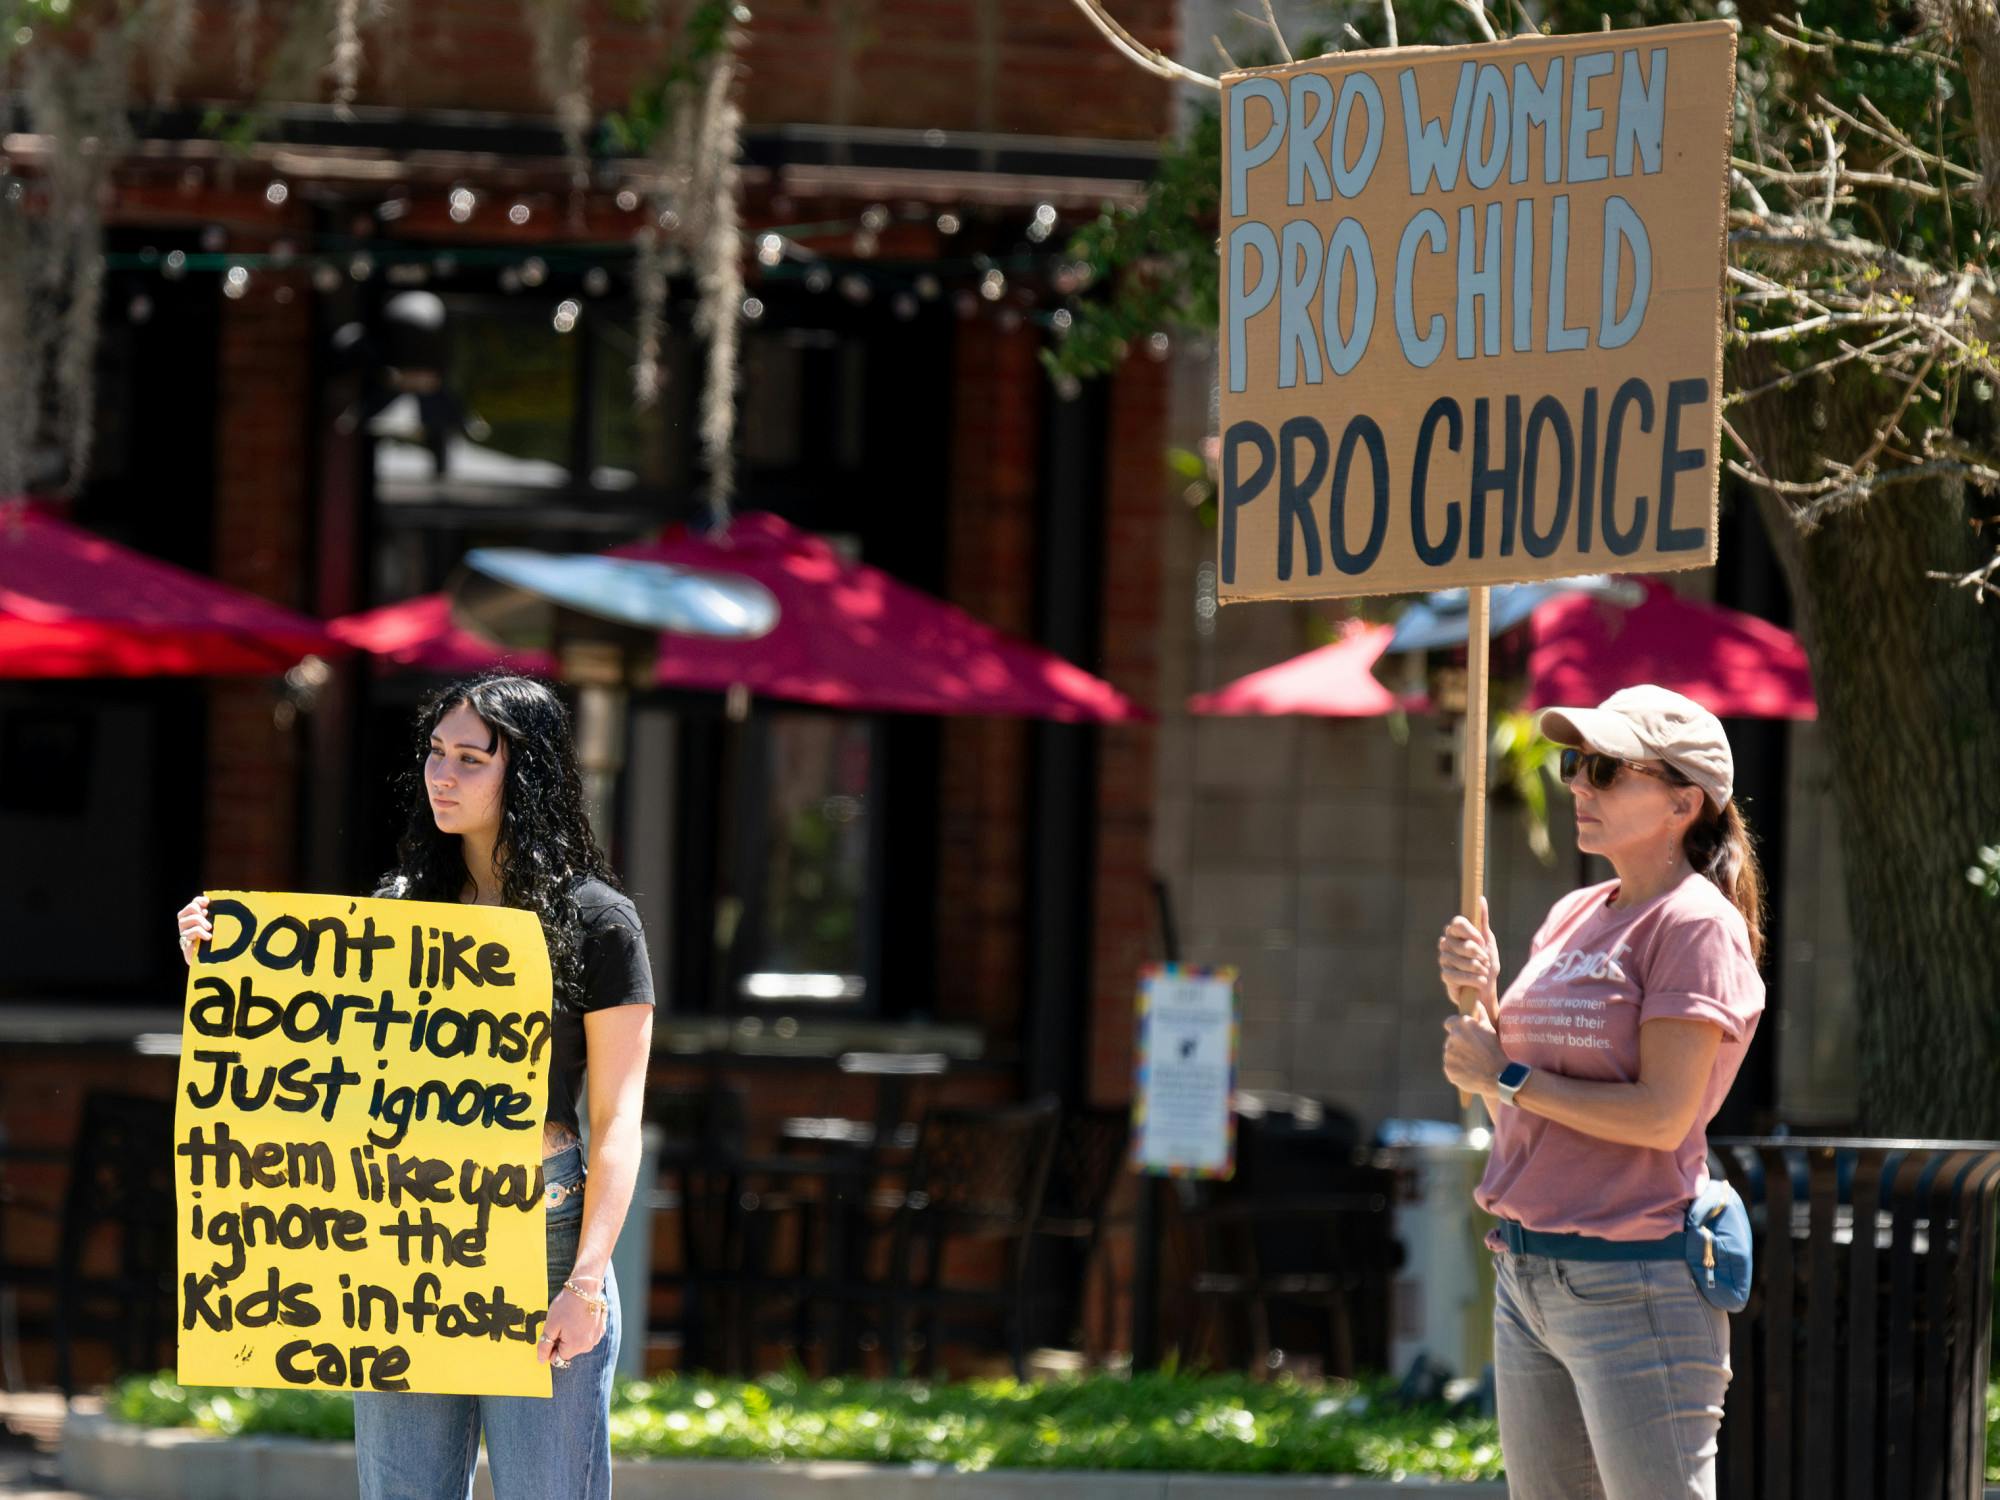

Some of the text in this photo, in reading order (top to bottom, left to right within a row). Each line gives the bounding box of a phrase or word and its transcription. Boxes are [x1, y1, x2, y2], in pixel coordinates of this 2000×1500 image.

[1229, 47, 1668, 217] PRO WOMEN
[1229, 195, 1652, 393] PRO CHILD
[1221, 377, 1708, 584] PRO CHOICE
[197, 899, 515, 989] Don't like
[190, 976, 551, 1081] abortions?
[1564, 998, 1606, 1011] women
[1568, 1033, 1614, 1049] bodies.
[1575, 1015, 1606, 1029] their
[187, 1050, 535, 1148] Just ignore
[177, 1122, 545, 1235] them like you
[191, 1191, 486, 1280] ignore the
[183, 1267, 546, 1345] Kids in foster
[275, 1340, 411, 1391] care
